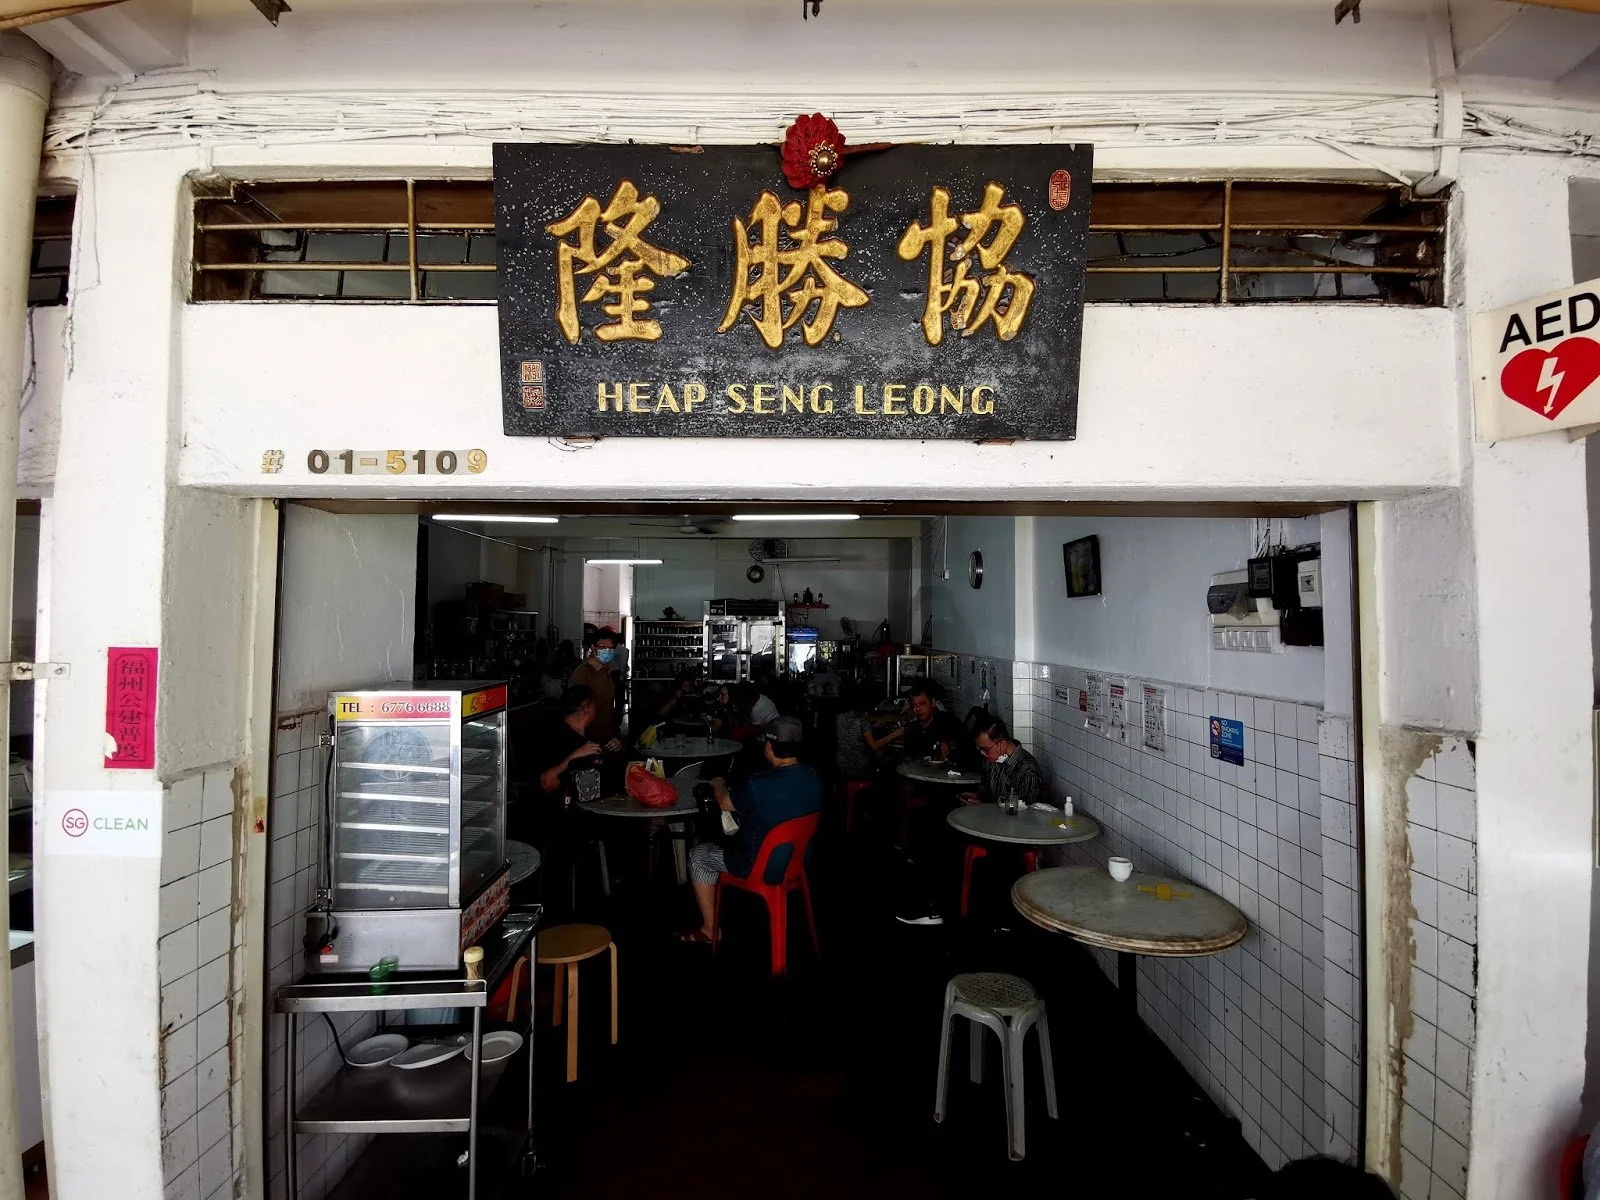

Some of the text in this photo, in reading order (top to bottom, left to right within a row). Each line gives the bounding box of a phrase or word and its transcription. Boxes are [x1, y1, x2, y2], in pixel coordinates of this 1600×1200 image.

[1499, 292, 1600, 353] AED
[597, 381, 995, 416] HEAP SENG LEONG
[307, 448, 488, 475] 01-5109
[340, 702, 363, 713] TEL
[381, 701, 414, 714] 6776
[416, 701, 450, 714] 6688
[65, 816, 149, 831] SG CLEAN
